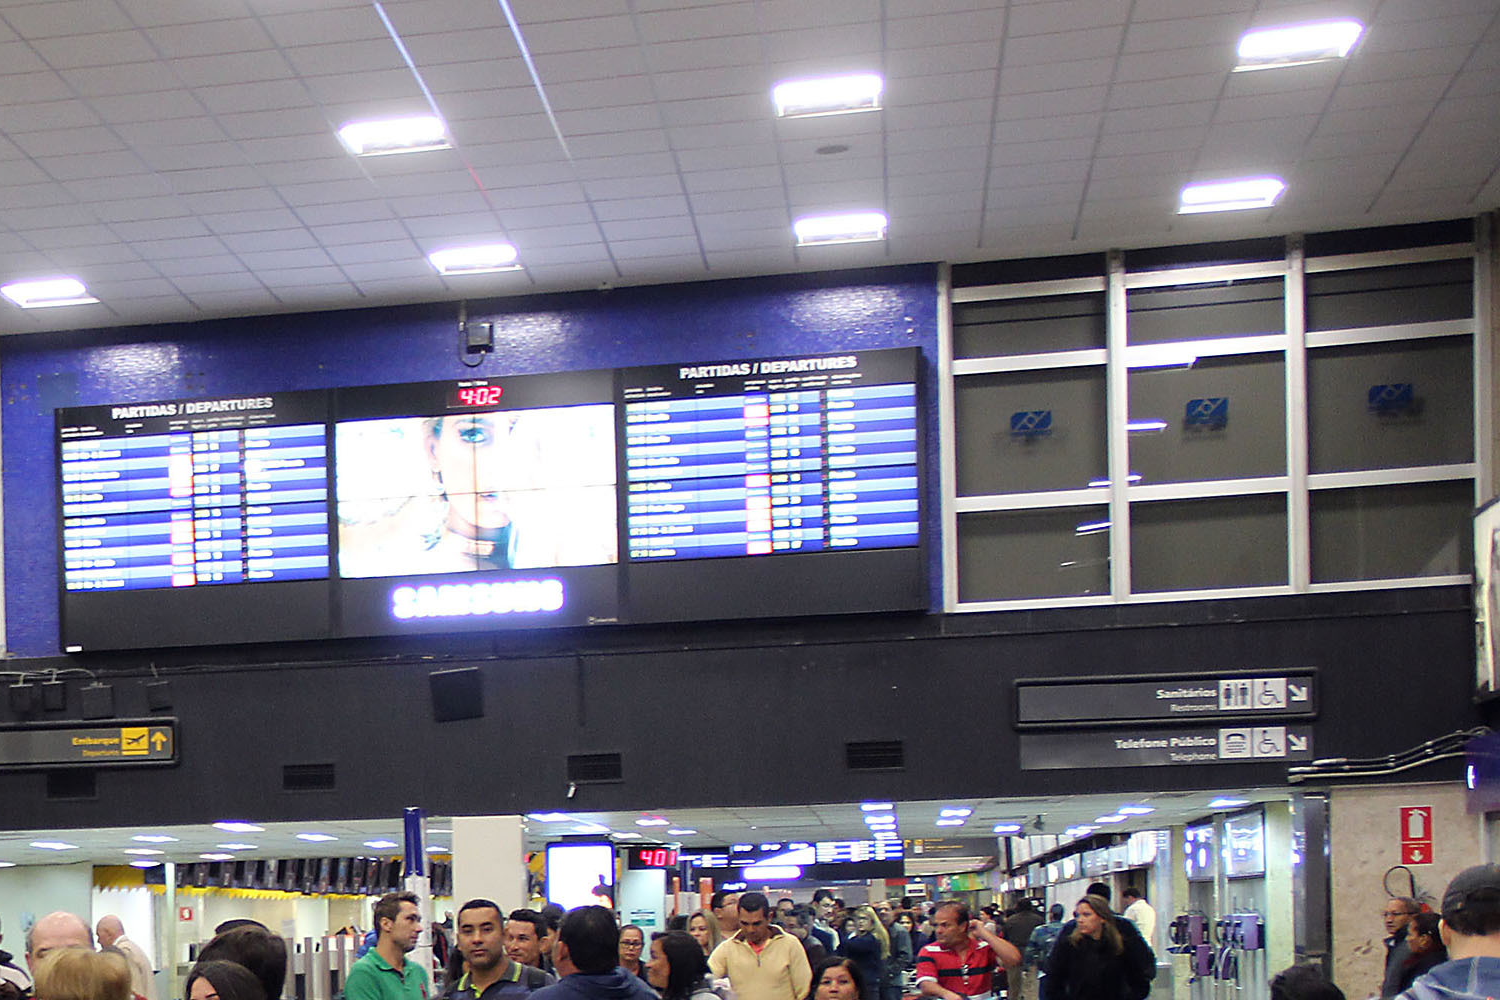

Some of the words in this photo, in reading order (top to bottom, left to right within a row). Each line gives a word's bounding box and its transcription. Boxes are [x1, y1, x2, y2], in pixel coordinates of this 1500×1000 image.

[679, 362, 750, 380] PARTIDAS
[760, 355, 858, 375] DEPARTURES
[111, 403, 177, 419] PARTIDAS
[186, 397, 274, 414] DEPARTURES
[1156, 687, 1217, 699] Sanitários
[1115, 738, 1168, 749] Telefone
[1169, 736, 1217, 747] Público
